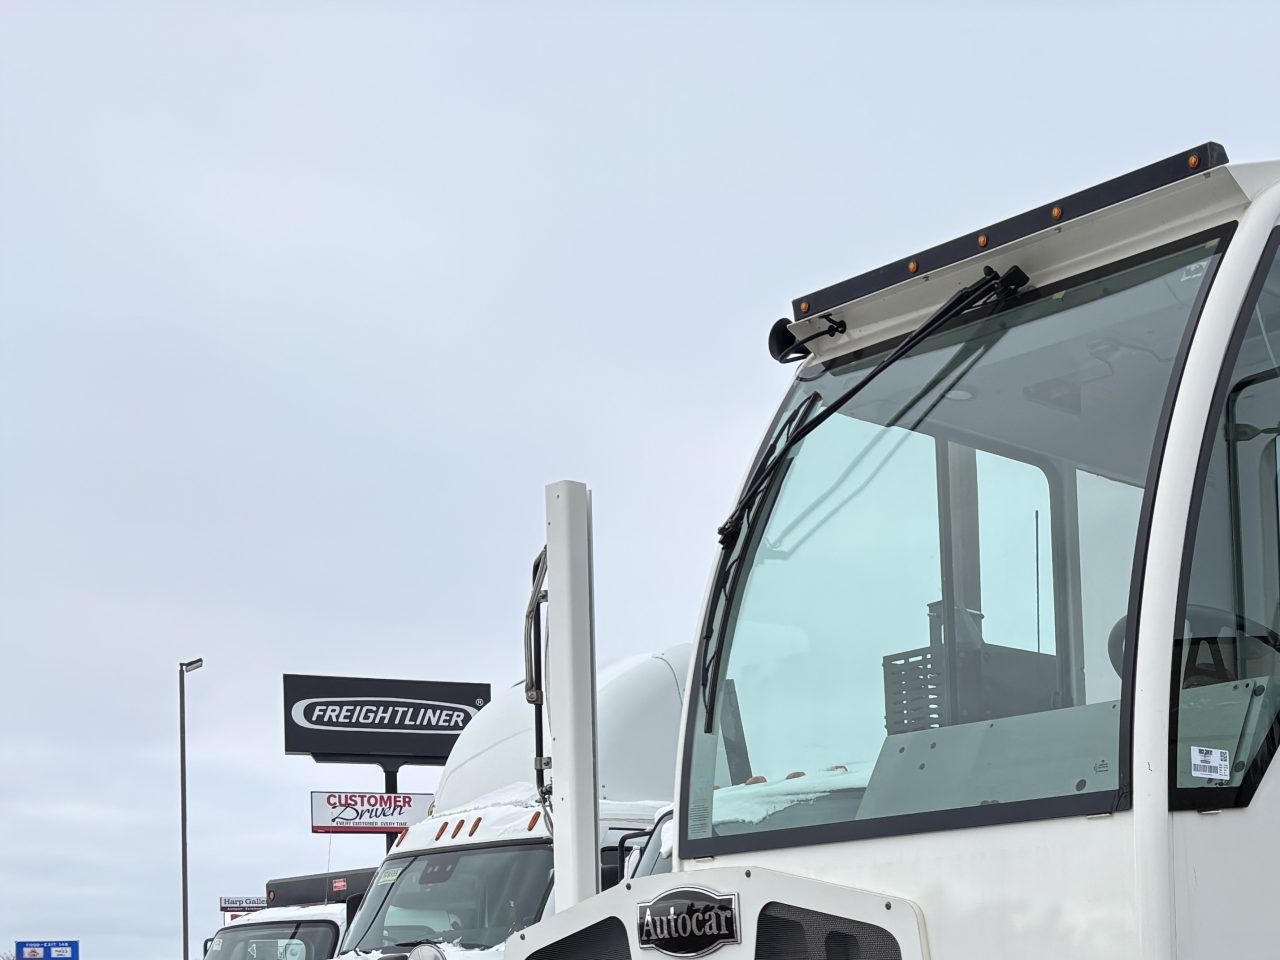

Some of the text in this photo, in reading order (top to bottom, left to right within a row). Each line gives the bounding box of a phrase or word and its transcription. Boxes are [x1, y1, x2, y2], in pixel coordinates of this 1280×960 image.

[311, 705, 465, 727] FREIGHTLINER
[326, 794, 413, 807] CUSTOMER
[331, 803, 405, 823] Driven
[224, 898, 243, 906] Harp
[641, 906, 732, 940] Autocar
